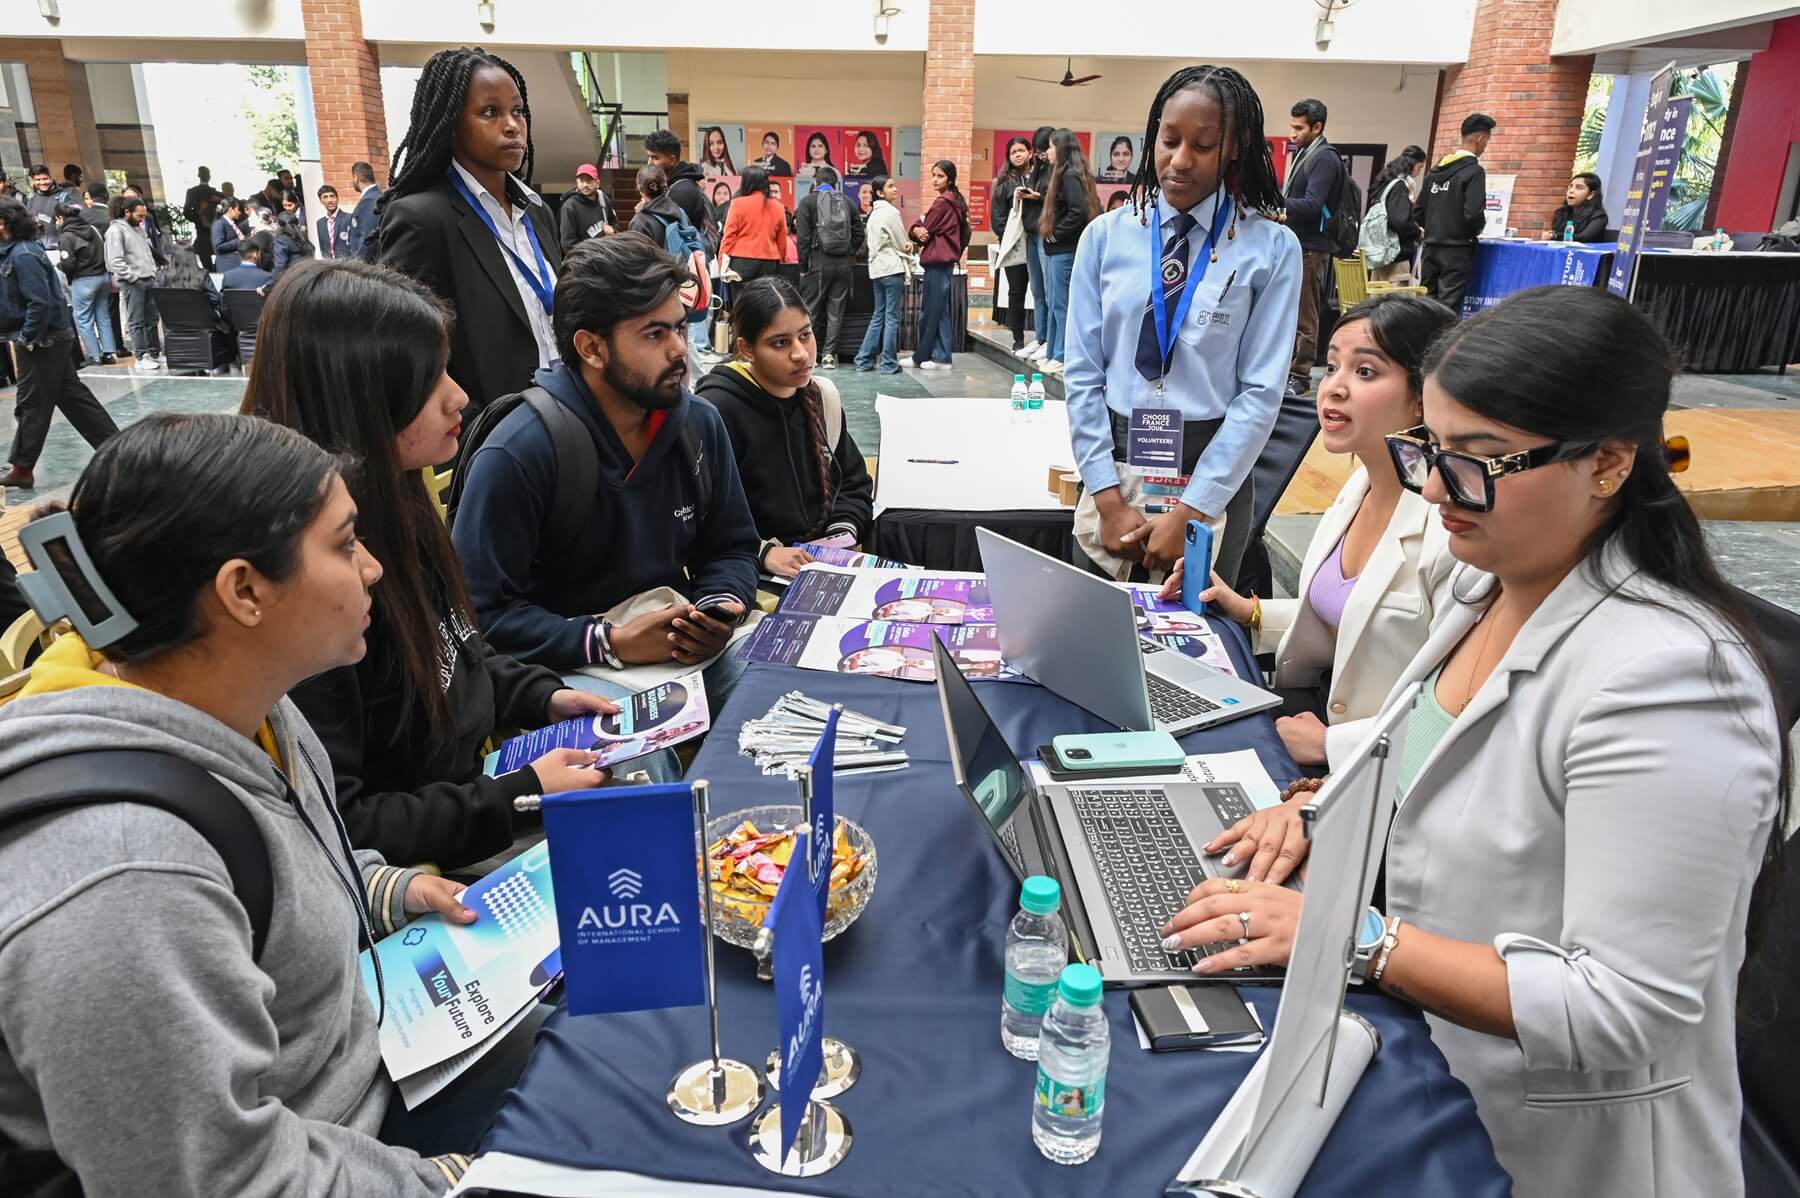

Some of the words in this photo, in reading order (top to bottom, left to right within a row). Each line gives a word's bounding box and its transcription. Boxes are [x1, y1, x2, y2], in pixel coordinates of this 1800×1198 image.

[1137, 437, 1173, 445] VOLUNTEERS
[1146, 476, 1188, 485] LENCE
[648, 690, 659, 721] BUSINESS
[1181, 762, 1199, 783] xplor
[576, 902, 680, 930] AURA
[577, 929, 645, 938] INTERNATIONAL
[647, 926, 681, 934] SCHOOL
[591, 936, 651, 945] MANAGEMENT
[430, 970, 453, 1000] Your
[446, 997, 473, 1040] Future
[464, 979, 495, 1026] Explore
[787, 976, 822, 1070] AURA
